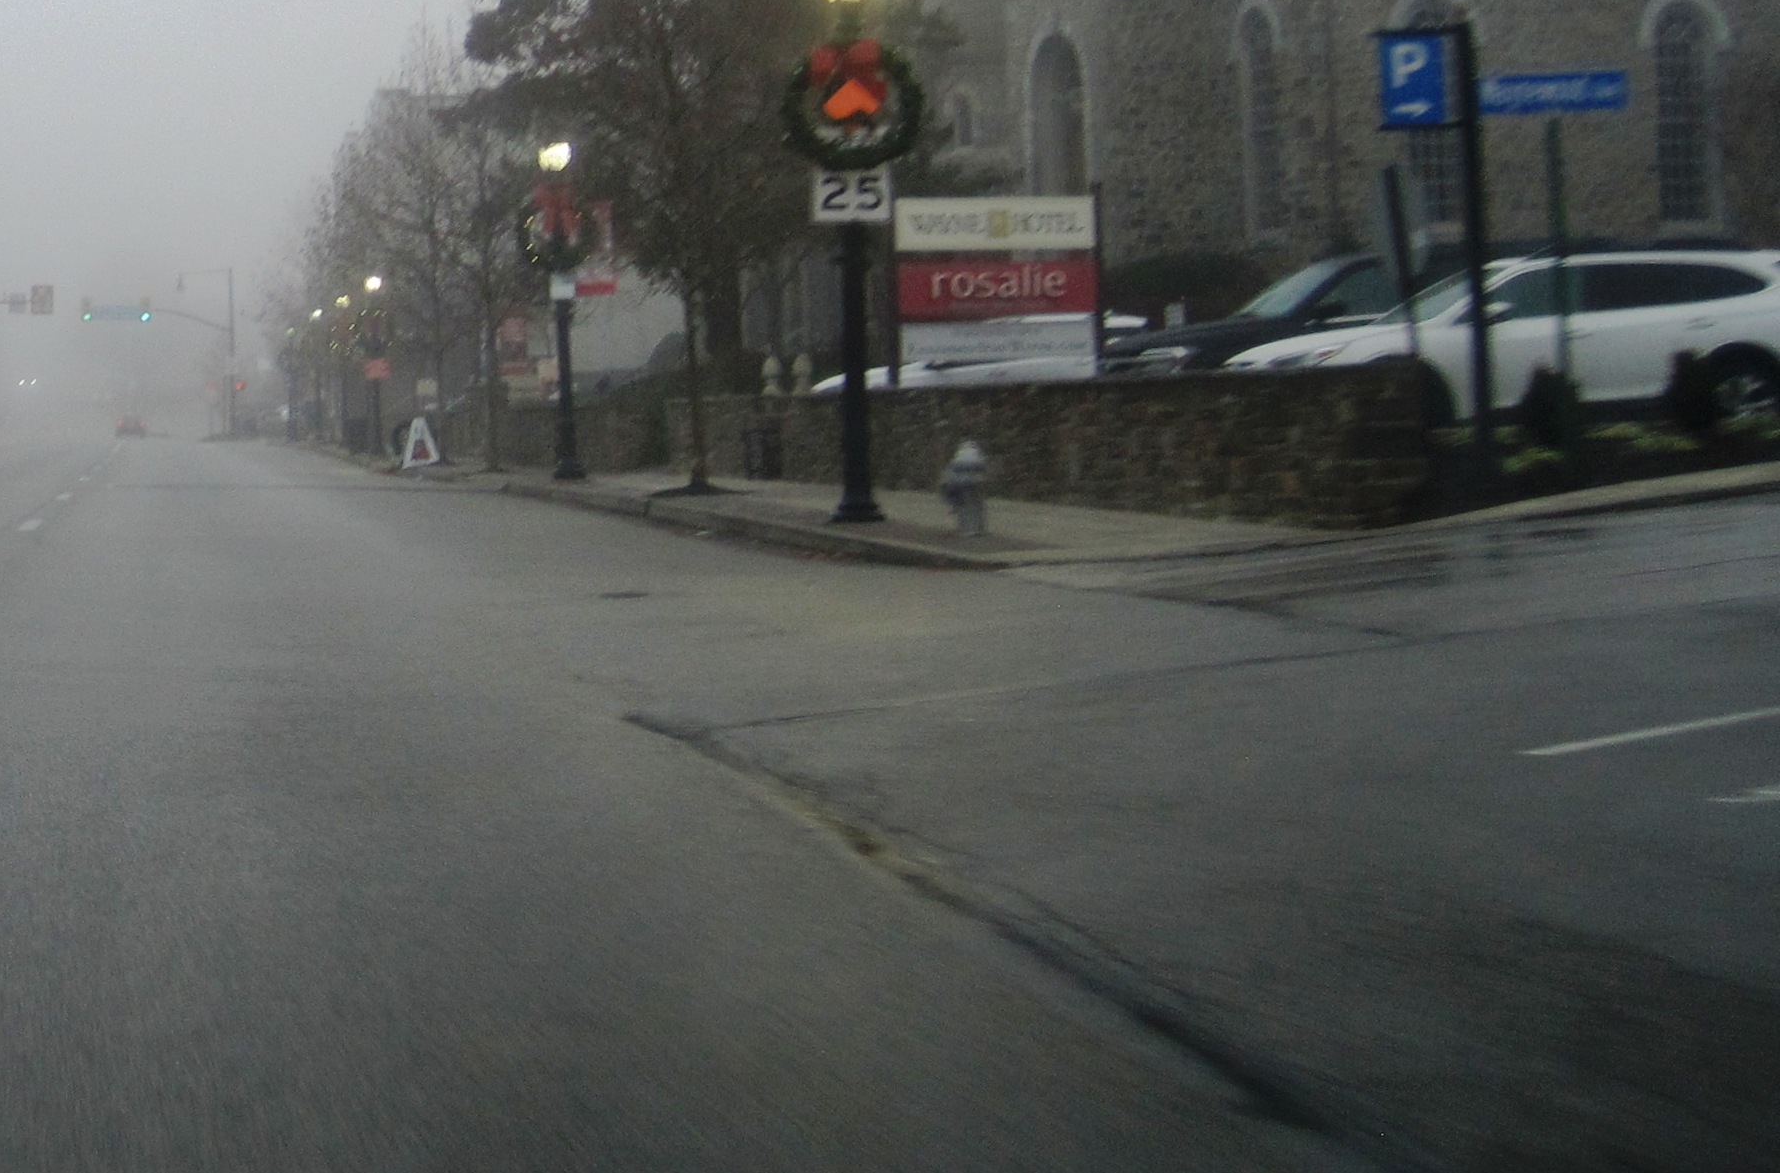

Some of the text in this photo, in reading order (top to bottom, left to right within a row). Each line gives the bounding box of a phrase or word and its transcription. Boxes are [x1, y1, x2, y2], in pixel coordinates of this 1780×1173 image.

[1391, 42, 1427, 87] P
[822, 177, 882, 210] 25
[1010, 211, 1085, 234] HOTEL
[930, 264, 1068, 299] rosalie
